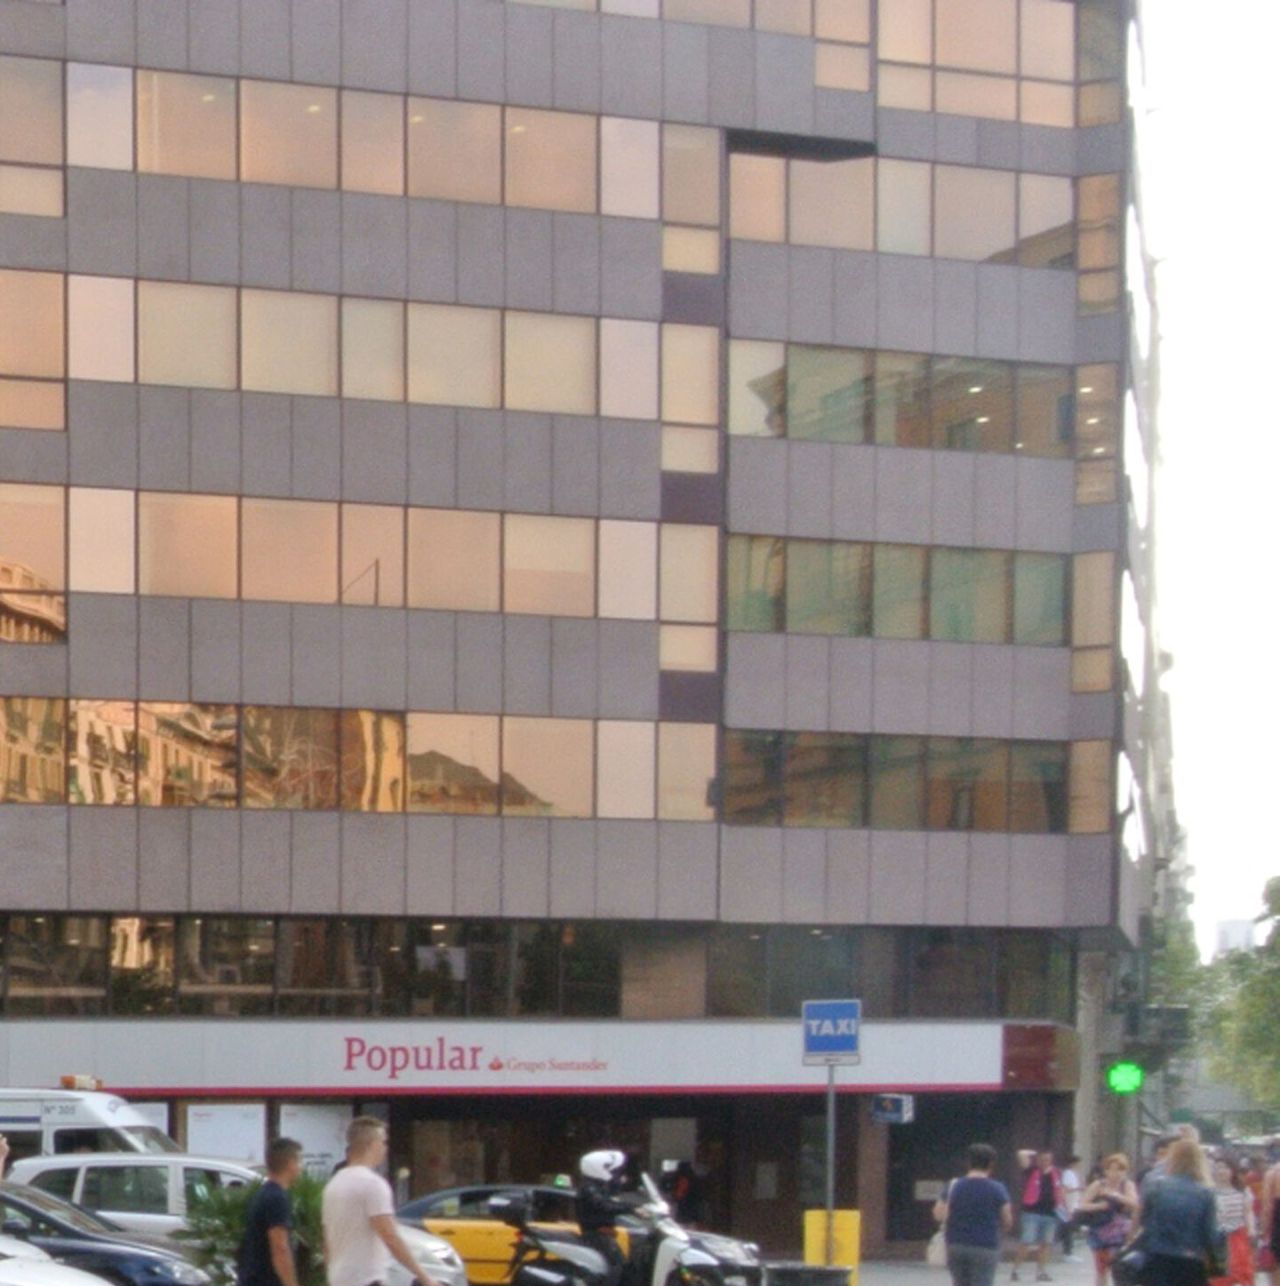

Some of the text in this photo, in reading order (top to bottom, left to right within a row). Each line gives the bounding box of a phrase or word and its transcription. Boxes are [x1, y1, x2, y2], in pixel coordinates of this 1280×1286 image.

[807, 1018, 856, 1036] TAXI
[343, 1036, 608, 1079] Popular Grupo Santander
